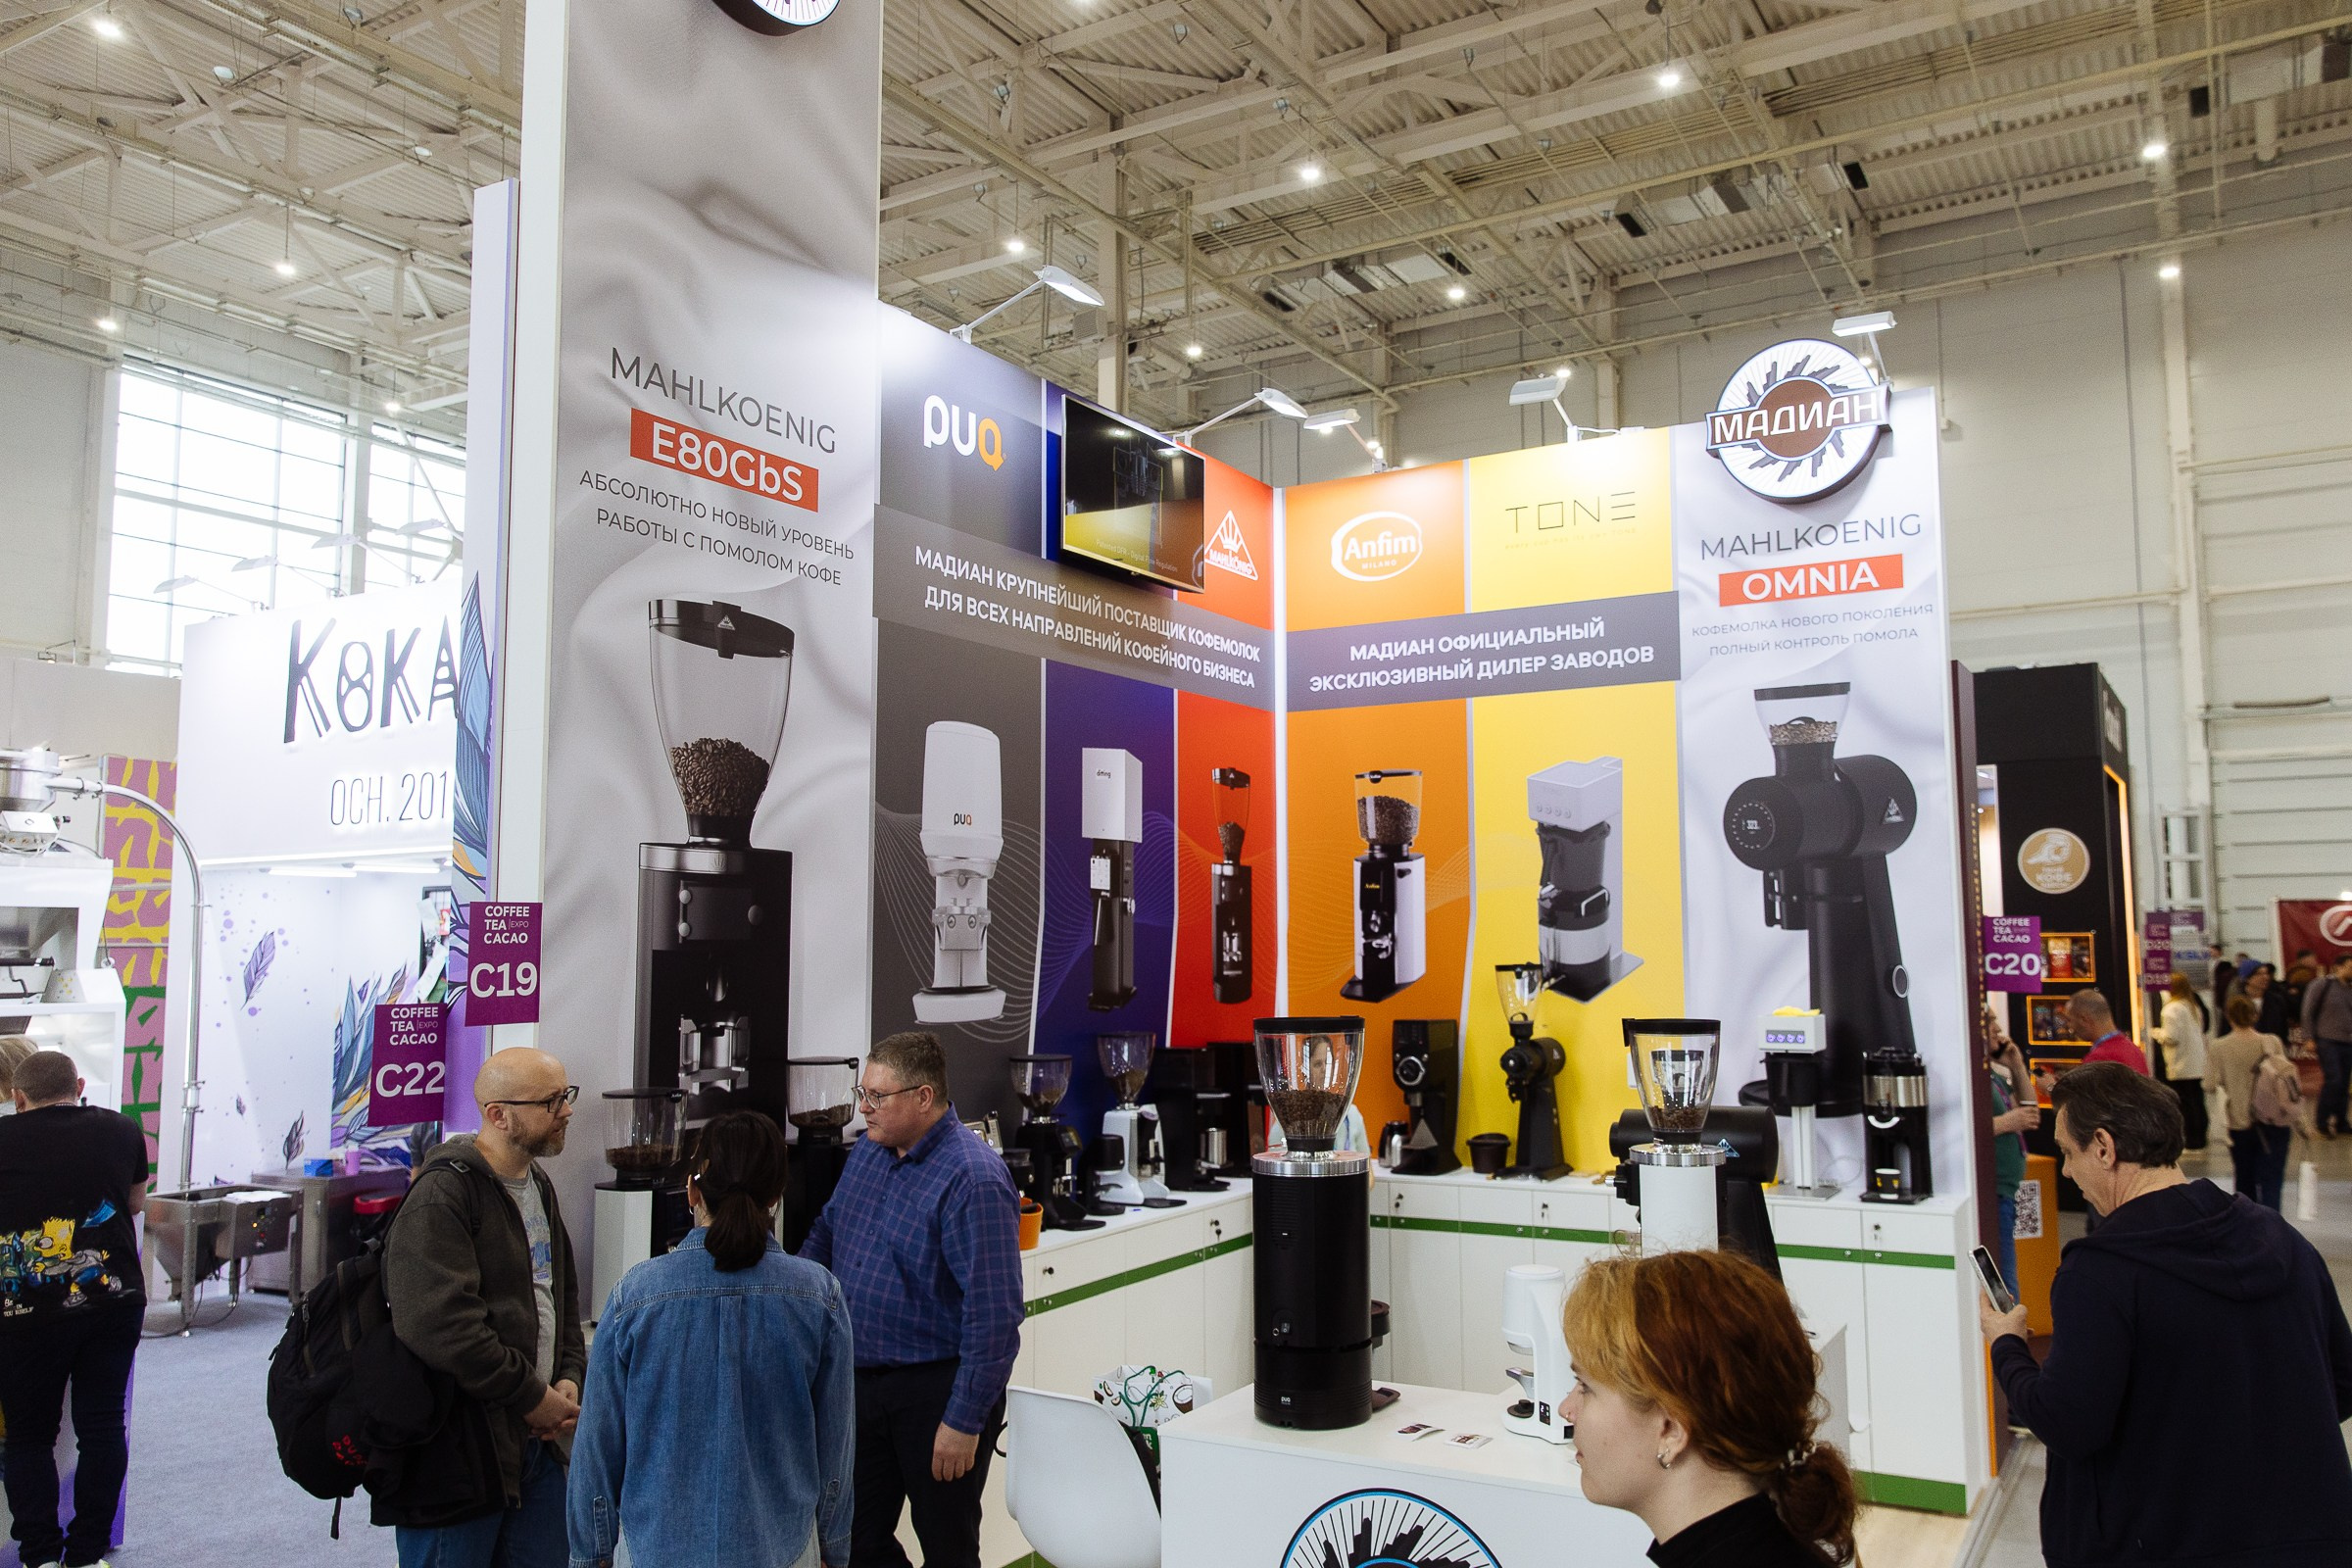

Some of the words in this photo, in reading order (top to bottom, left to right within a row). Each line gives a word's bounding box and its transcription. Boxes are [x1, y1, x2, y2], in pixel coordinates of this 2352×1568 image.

[612, 347, 836, 454] MAHLKOENIG
[1714, 393, 1879, 444] МАДИАН
[652, 421, 803, 502] E80GbS
[579, 470, 707, 519] АБСОЛЮТНО
[712, 506, 776, 539] НОВЫЙ
[781, 525, 855, 561] УРОВЕНЬ
[1505, 492, 1636, 533] TONE
[597, 509, 677, 544] РАБОТЫ
[683, 531, 695, 548] С
[701, 535, 793, 573] ПОМОЛОМ
[798, 561, 842, 586] КОФЕ
[1344, 530, 1417, 562] Anfim
[1701, 513, 1922, 561] MAHLKOENIG
[1361, 560, 1397, 570] MILANO
[1742, 562, 1880, 601] OMNIA
[915, 545, 992, 586] МАДИАН
[997, 568, 1101, 617] КРУПНЕЙШИЙ
[1105, 599, 1185, 643] ПОСТАВЩИК
[1188, 624, 1260, 662] КОФЕМОЛОК
[1691, 617, 1778, 637] КОФЕМОЛКА
[1782, 612, 1838, 629] НОВОГО
[1841, 604, 1934, 623] ПОКОЛЕНИЯ
[924, 586, 962, 613] ДЛЯ
[966, 599, 1008, 626] ВСЕХ
[1012, 610, 1121, 654] НАПРАВЛЕНИЙ
[1124, 636, 1201, 674] КОФЕЙНОГО
[1203, 661, 1255, 688] БИЗНЕСА
[1349, 638, 1434, 662] МАДИАН
[1438, 616, 1605, 655] ОФИЦИАЛЬНЫЙ
[1709, 639, 1771, 658] ПОЛНЫЙ
[1774, 633, 1849, 652] КОНТРОЛЬ
[1853, 628, 1919, 645] ПОМОЛА
[1308, 660, 1473, 694] ЭКСКЛЮЗИВНЫЙ
[1477, 655, 1546, 682] ДИЛЕР
[1550, 645, 1654, 671] ЗАВОДОВ
[484, 905, 529, 917] COFFEE
[484, 919, 507, 931] TEA
[511, 920, 529, 929] EXPO
[1992, 917, 2031, 926] COFFEE
[484, 932, 528, 945] CACAO
[1992, 926, 2012, 935] TEA
[1992, 934, 2032, 944] CACAO
[469, 961, 538, 999] C19
[1984, 952, 2040, 976] C20
[390, 1006, 438, 1019] COFFEE
[390, 1020, 415, 1032] TEA
[418, 1020, 438, 1029] EXPO
[389, 1033, 438, 1046] CACAO
[375, 1060, 445, 1098] C22
